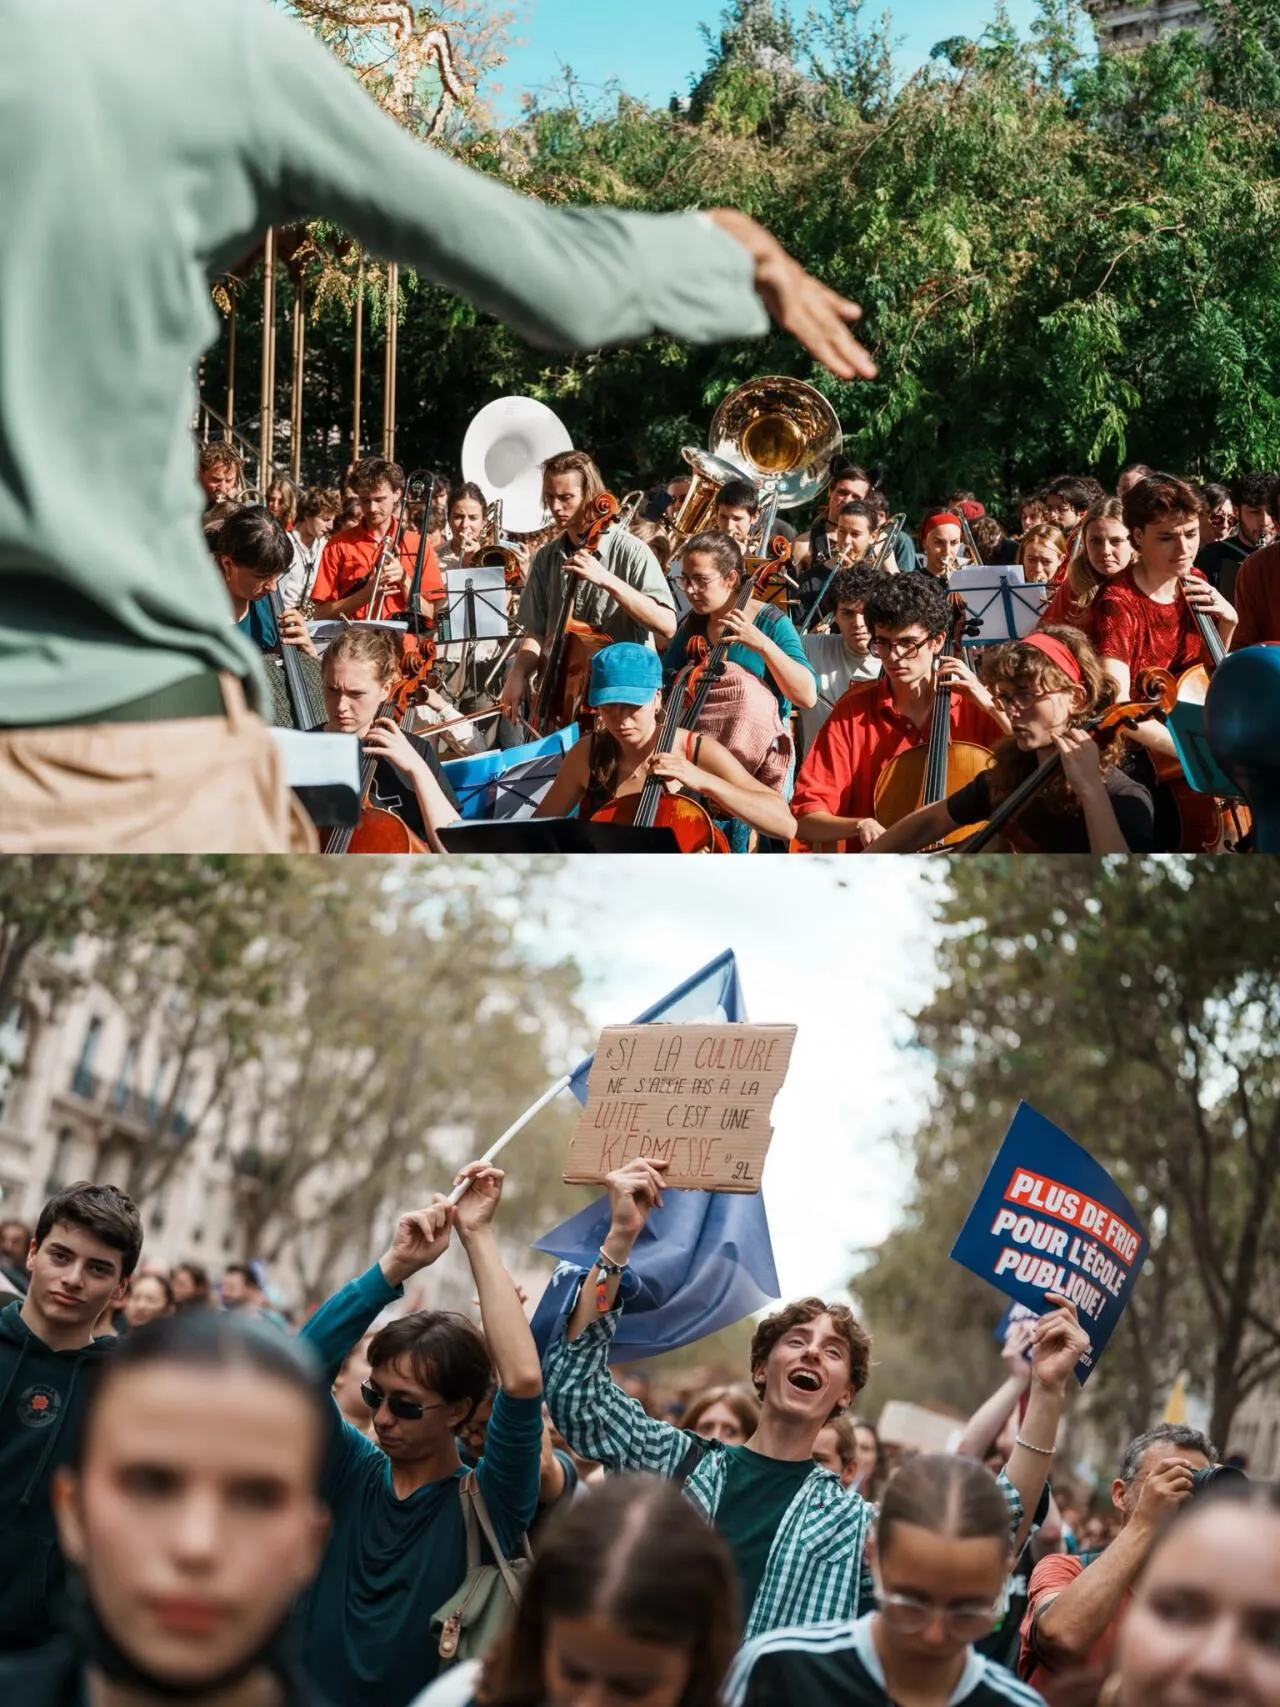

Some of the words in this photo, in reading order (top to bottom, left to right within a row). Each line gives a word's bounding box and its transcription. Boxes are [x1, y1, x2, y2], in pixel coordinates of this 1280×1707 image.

[653, 1034, 682, 1072] LA
[694, 1036, 780, 1072] CULTURE
[606, 1077, 627, 1094] NE
[691, 1078, 714, 1095] PAS
[740, 1080, 760, 1096] LA
[665, 1103, 712, 1128] C'EST
[720, 1108, 756, 1130] UNE
[1009, 1173, 1081, 1220] PLUS
[1079, 1200, 1109, 1237] DE
[1104, 1217, 1138, 1262] FRIC
[990, 1207, 1069, 1258] POUR
[1067, 1236, 1127, 1298] L'ÉCOLE
